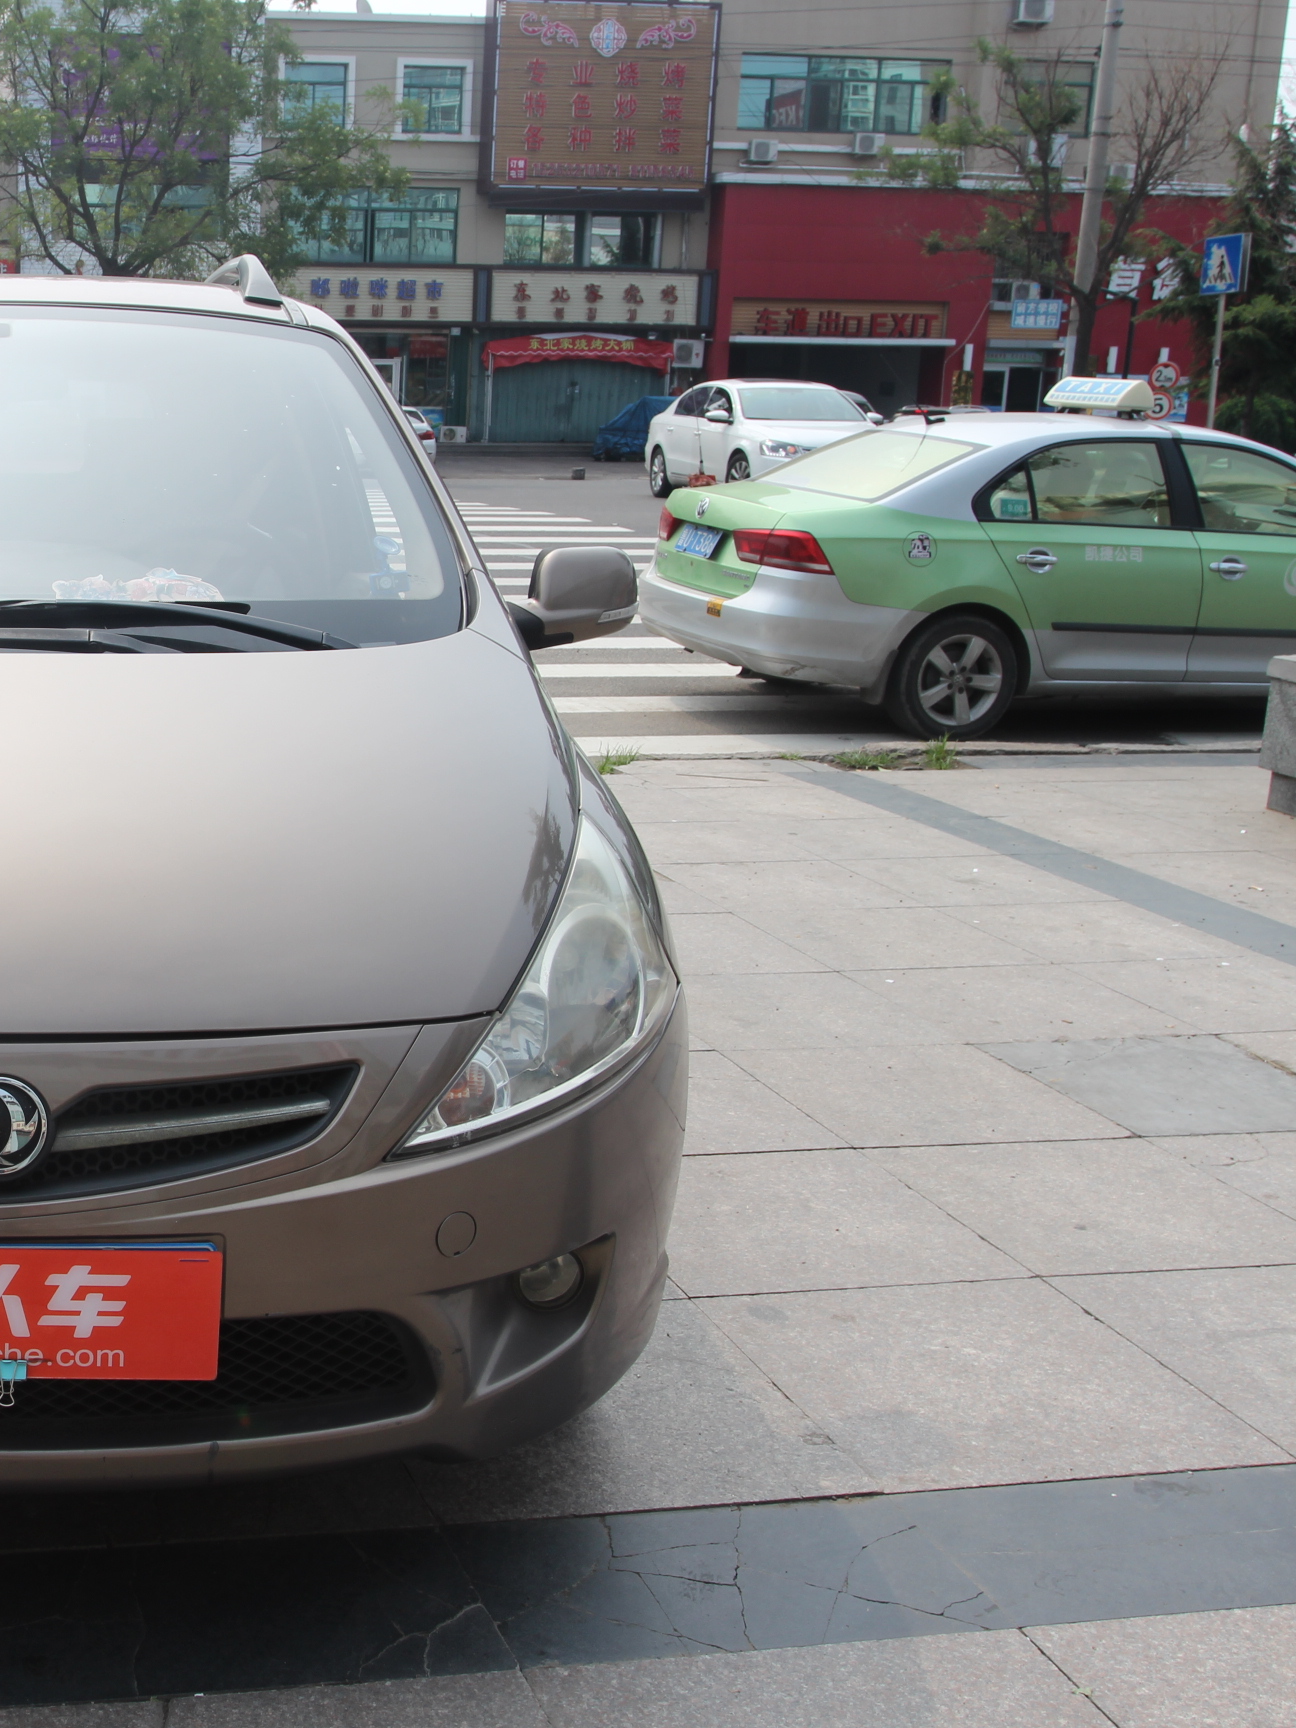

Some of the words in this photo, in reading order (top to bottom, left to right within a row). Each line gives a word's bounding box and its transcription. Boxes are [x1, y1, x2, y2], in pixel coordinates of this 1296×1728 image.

[526, 58, 687, 88] 专业烧烤
[523, 91, 684, 121] 特色炒菜
[523, 124, 682, 153] 各种拌菜
[1066, 381, 1123, 393] TAXI
[1085, 545, 1143, 563] 凯捷公司
